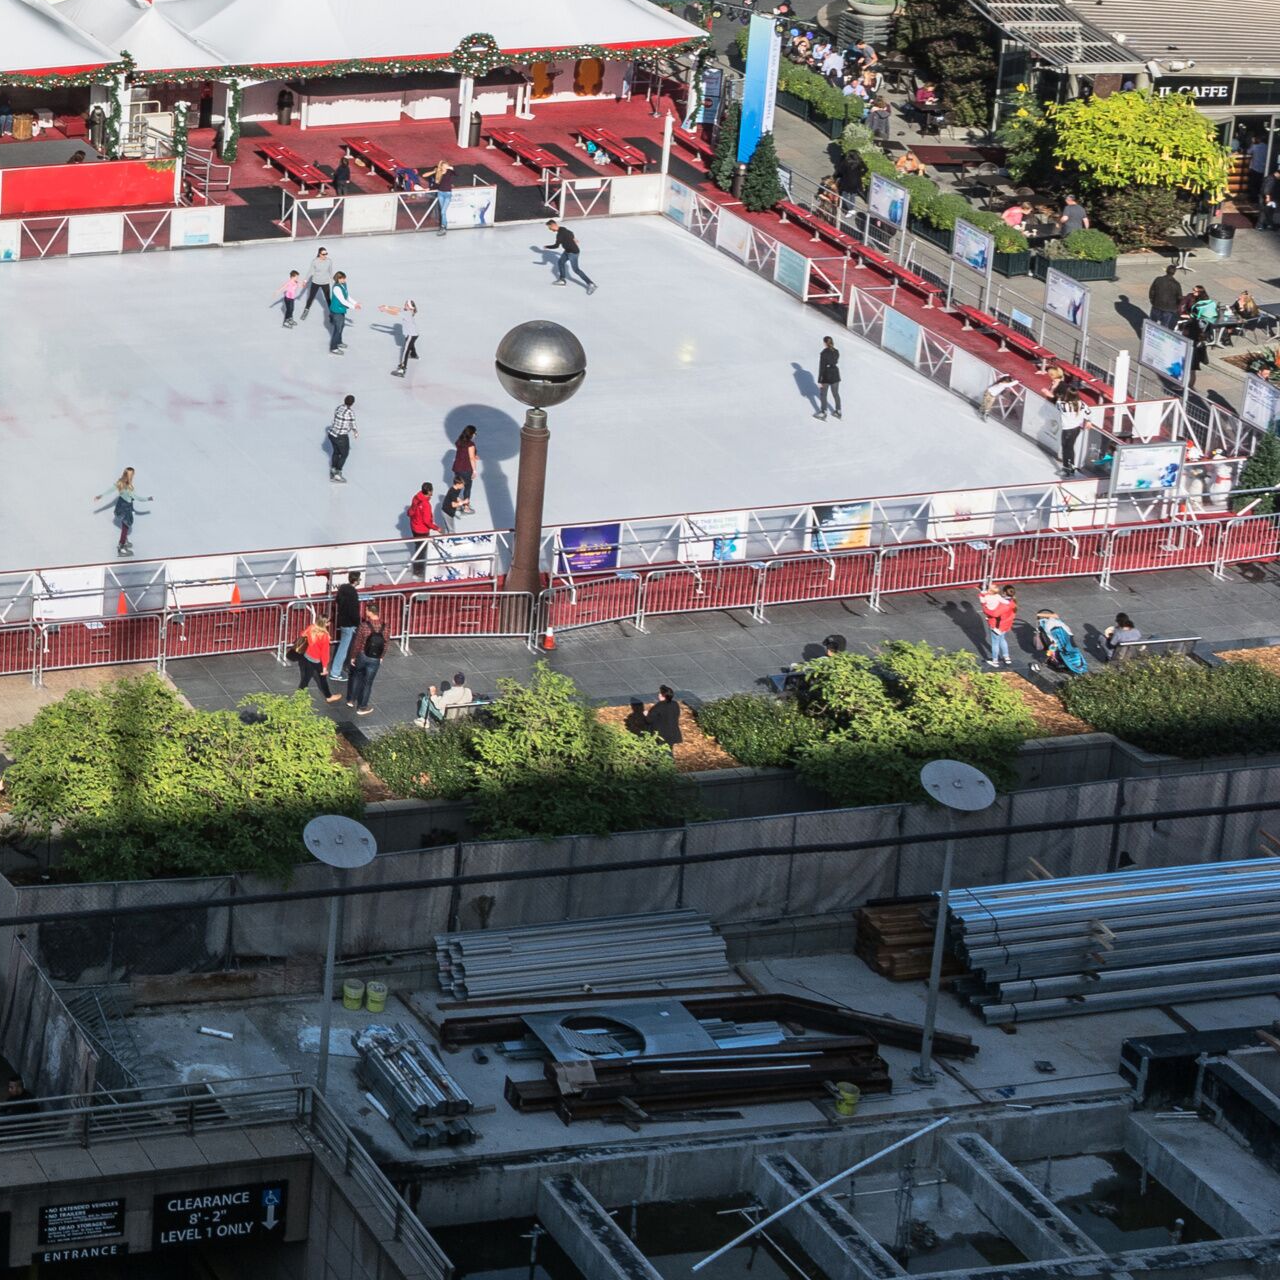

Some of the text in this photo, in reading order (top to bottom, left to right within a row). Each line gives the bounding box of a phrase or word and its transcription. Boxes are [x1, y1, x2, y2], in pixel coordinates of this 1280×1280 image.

[167, 1191, 250, 1213] CLEARANCE
[161, 1220, 254, 1245] LEVEL 1 ONLY
[44, 1245, 117, 1262] ENTRANCE
